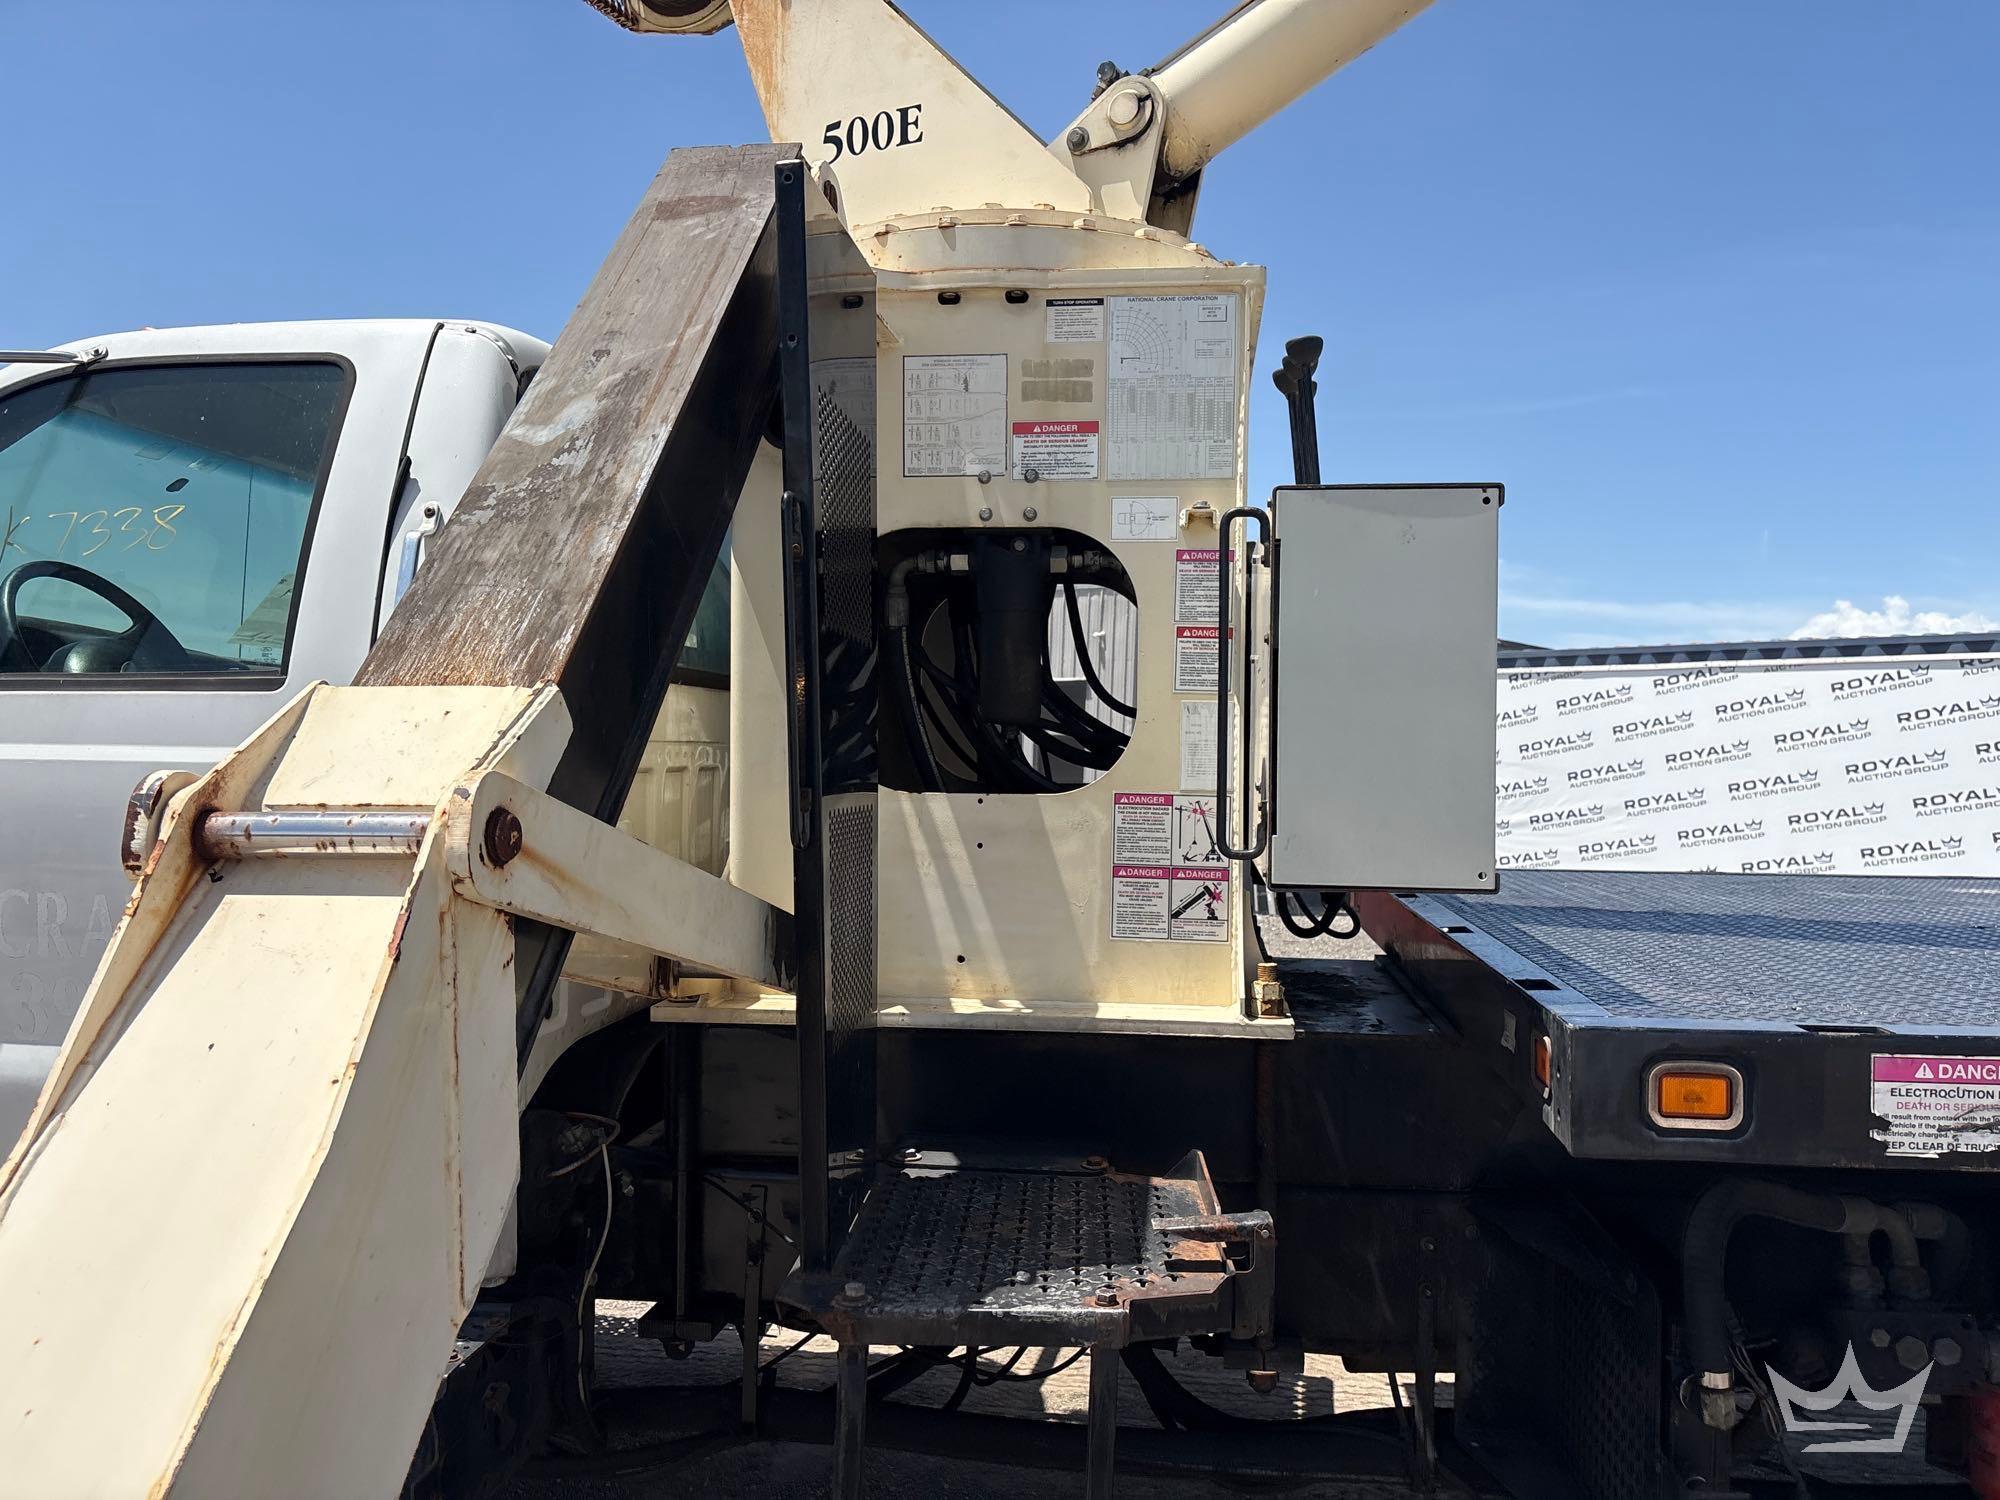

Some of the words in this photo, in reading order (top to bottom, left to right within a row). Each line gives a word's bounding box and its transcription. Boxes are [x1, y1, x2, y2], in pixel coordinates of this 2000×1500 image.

[822, 104, 924, 166] 500E
[1511, 676, 1550, 691] AUCTION
[1653, 668, 1718, 689] ROYAL
[1655, 682, 1700, 696] AUCTION
[1702, 675, 1739, 687] GROUP
[1831, 670, 1909, 693] ROYAL
[1834, 686, 1887, 702] AUCTION
[1889, 677, 1933, 691] GROUP
[1556, 689, 1616, 710] ROYAL
[1559, 704, 1599, 717] AUCTION
[1600, 696, 1634, 708] GROUP
[1715, 694, 1785, 716] ROYAL
[1718, 709, 1765, 723] AUCTION
[1767, 701, 1807, 714] GROUP
[1897, 701, 1979, 724] ROYAL
[1508, 716, 1539, 728] GROUP
[1612, 715, 1675, 736] ROYAL
[1900, 717, 1956, 733] AUCTION
[1614, 729, 1657, 743] AUCTION
[1658, 723, 1694, 735] GROUP
[1774, 723, 1849, 745] ROYAL
[1519, 735, 1577, 754] ROYAL
[1521, 747, 1560, 761] AUCTION
[1562, 742, 1594, 753] GROUP
[1776, 739, 1827, 753] AUCTION
[1829, 732, 1872, 745] GROUP
[1665, 744, 1732, 764] ROYAL
[1667, 757, 1713, 772] AUCTION
[1714, 752, 1752, 764] GROUP
[1567, 763, 1628, 781] ROYAL
[1845, 754, 1925, 775] ROYAL
[1848, 770, 1902, 784] AUCTION
[1904, 763, 1949, 775] GROUP
[1497, 780, 1533, 794] YAL
[1569, 776, 1610, 789] AUCTION
[1612, 771, 1646, 781] GROUP
[1728, 774, 1799, 794] ROYAL
[1129, 796, 1165, 804] DANGER
[1497, 792, 1517, 801] TION
[1519, 787, 1550, 798] GROUP
[1624, 792, 1688, 810] ROYAL
[1730, 788, 1778, 802] AUCTION
[1781, 782, 1821, 794] GROUP
[1912, 788, 1996, 809] ROYAL
[1529, 807, 1588, 825] ROYAL
[1626, 805, 1670, 817] AUCTION
[1671, 800, 1707, 811] GROUP
[1787, 806, 1864, 826] ROYAL
[1915, 804, 1973, 818] AUCTION
[1975, 800, 2000, 810] GRO
[1532, 820, 1571, 832] AUCTION
[1573, 816, 1605, 826] GROUP
[1677, 823, 1745, 841] ROYAL
[1790, 821, 1842, 834] AUCTION
[1844, 815, 1887, 827] GROUP
[1578, 838, 1639, 855] ROYAL
[1680, 836, 1725, 848] AUCTION
[1727, 832, 1765, 843] GROUP
[1499, 852, 1543, 865] OYAL
[1581, 850, 1622, 862] AUCTION
[1623, 846, 1658, 857] GROUP
[1860, 840, 1941, 859] ROYAL
[1741, 856, 1814, 873] ROYAL
[1863, 855, 1918, 868] AUCTION
[1921, 850, 1965, 862] GROUP
[1127, 869, 1163, 877] DANGER
[1938, 1064, 2000, 1080] DANG
[1890, 1087, 1995, 1099] ELECTROCUTION
[1897, 1102, 1931, 1110] DEATH
[1935, 1103, 1950, 1111] OR
[1918, 1131, 1950, 1139] charged.
[1908, 1142, 1944, 1150] CLEAR
[1947, 1143, 1961, 1151] OF
